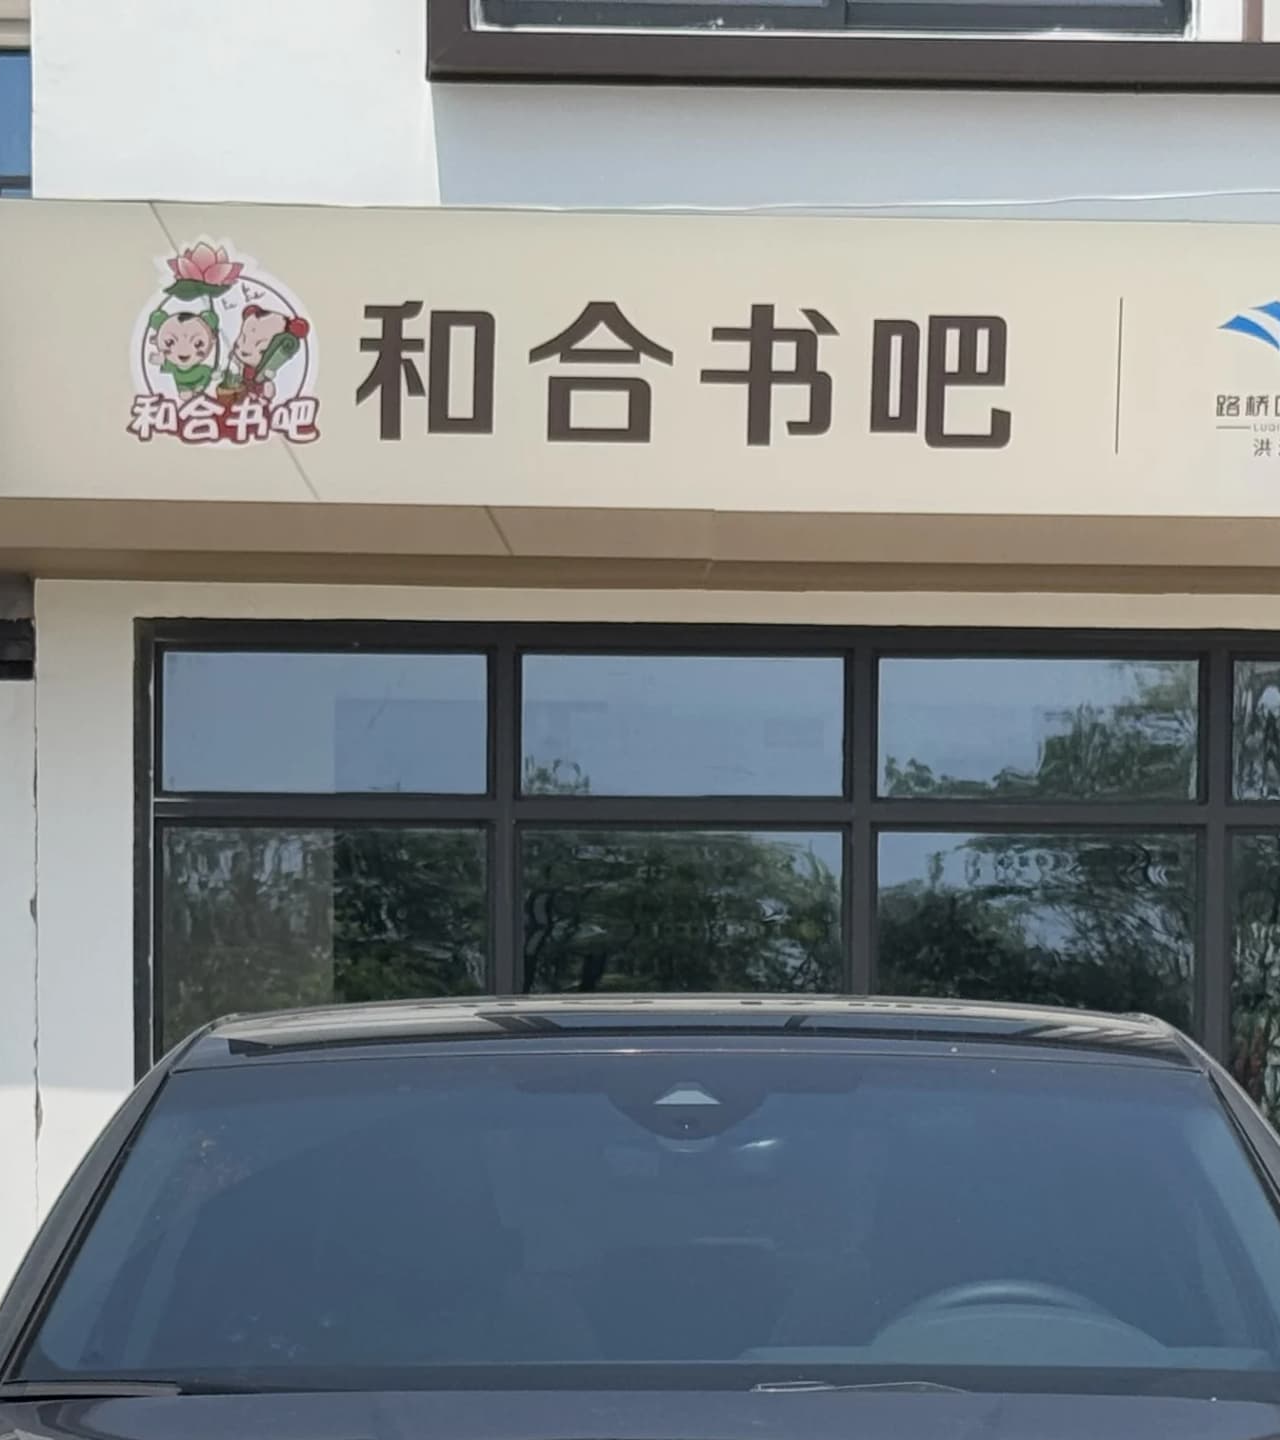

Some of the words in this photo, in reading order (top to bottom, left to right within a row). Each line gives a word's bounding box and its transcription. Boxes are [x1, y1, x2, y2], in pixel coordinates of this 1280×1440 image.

[127, 393, 320, 444] 和合书吧
[356, 299, 1013, 450] 和合书吧
